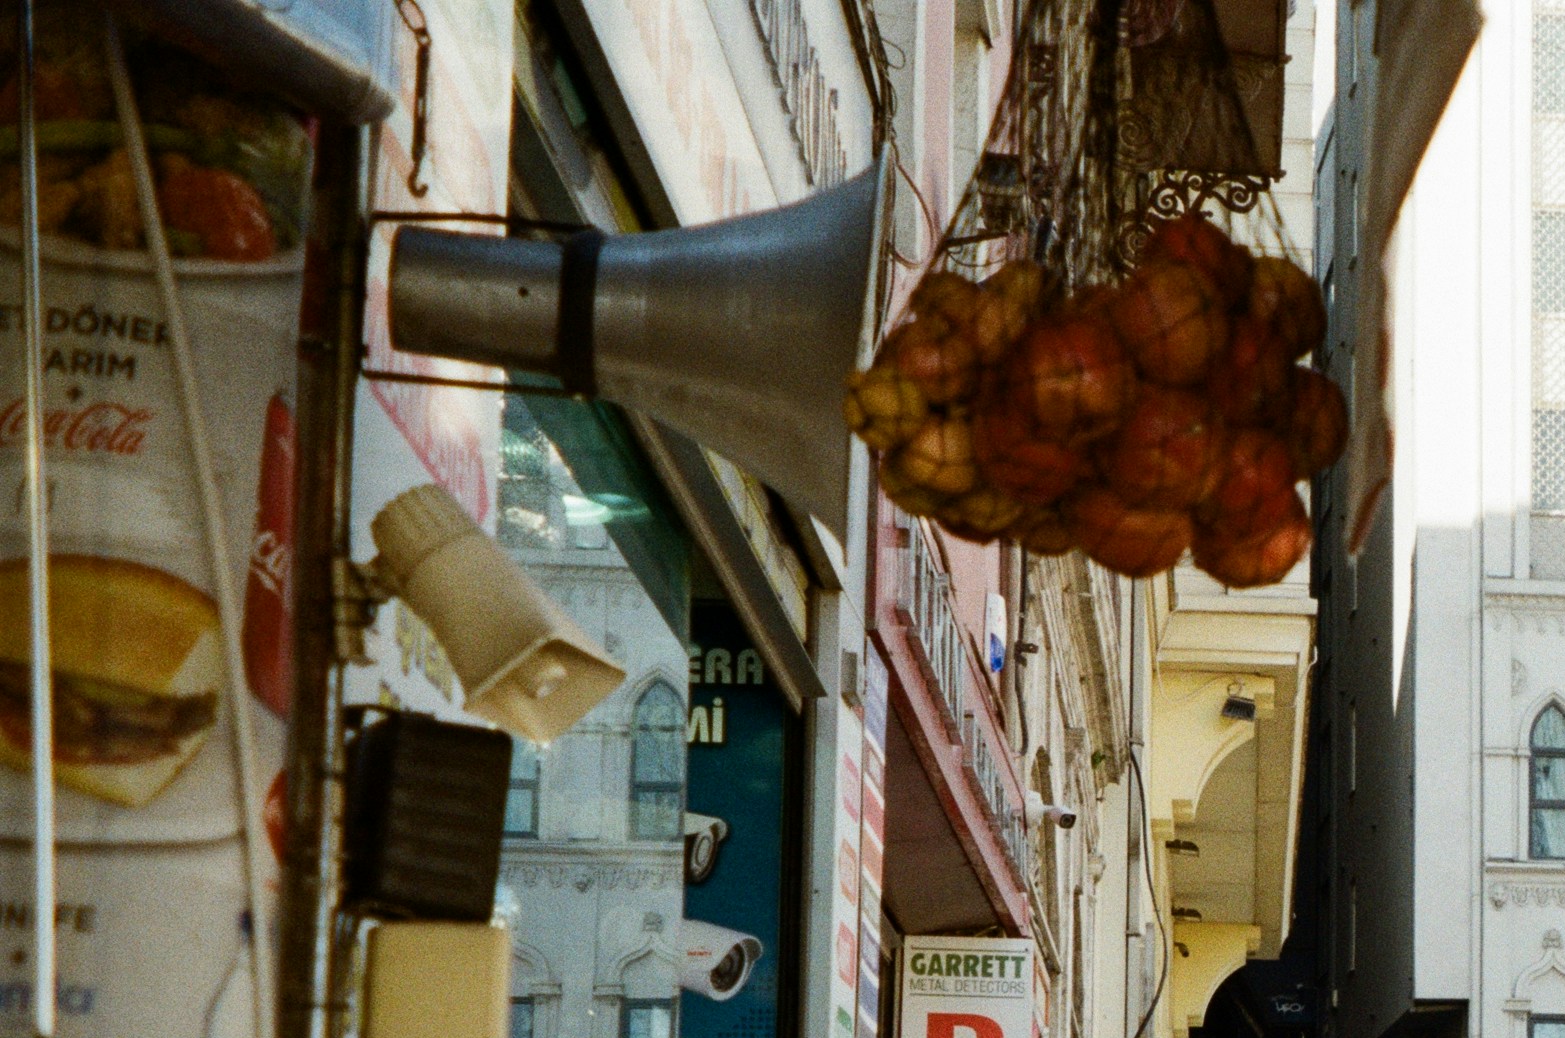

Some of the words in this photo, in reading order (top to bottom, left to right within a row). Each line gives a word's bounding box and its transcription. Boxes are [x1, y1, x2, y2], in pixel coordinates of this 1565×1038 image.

[42, 349, 136, 380] ARIM
[910, 952, 1026, 979] GARRETT
[909, 978, 949, 993] METAL
[954, 979, 1025, 994] DETECTORS
